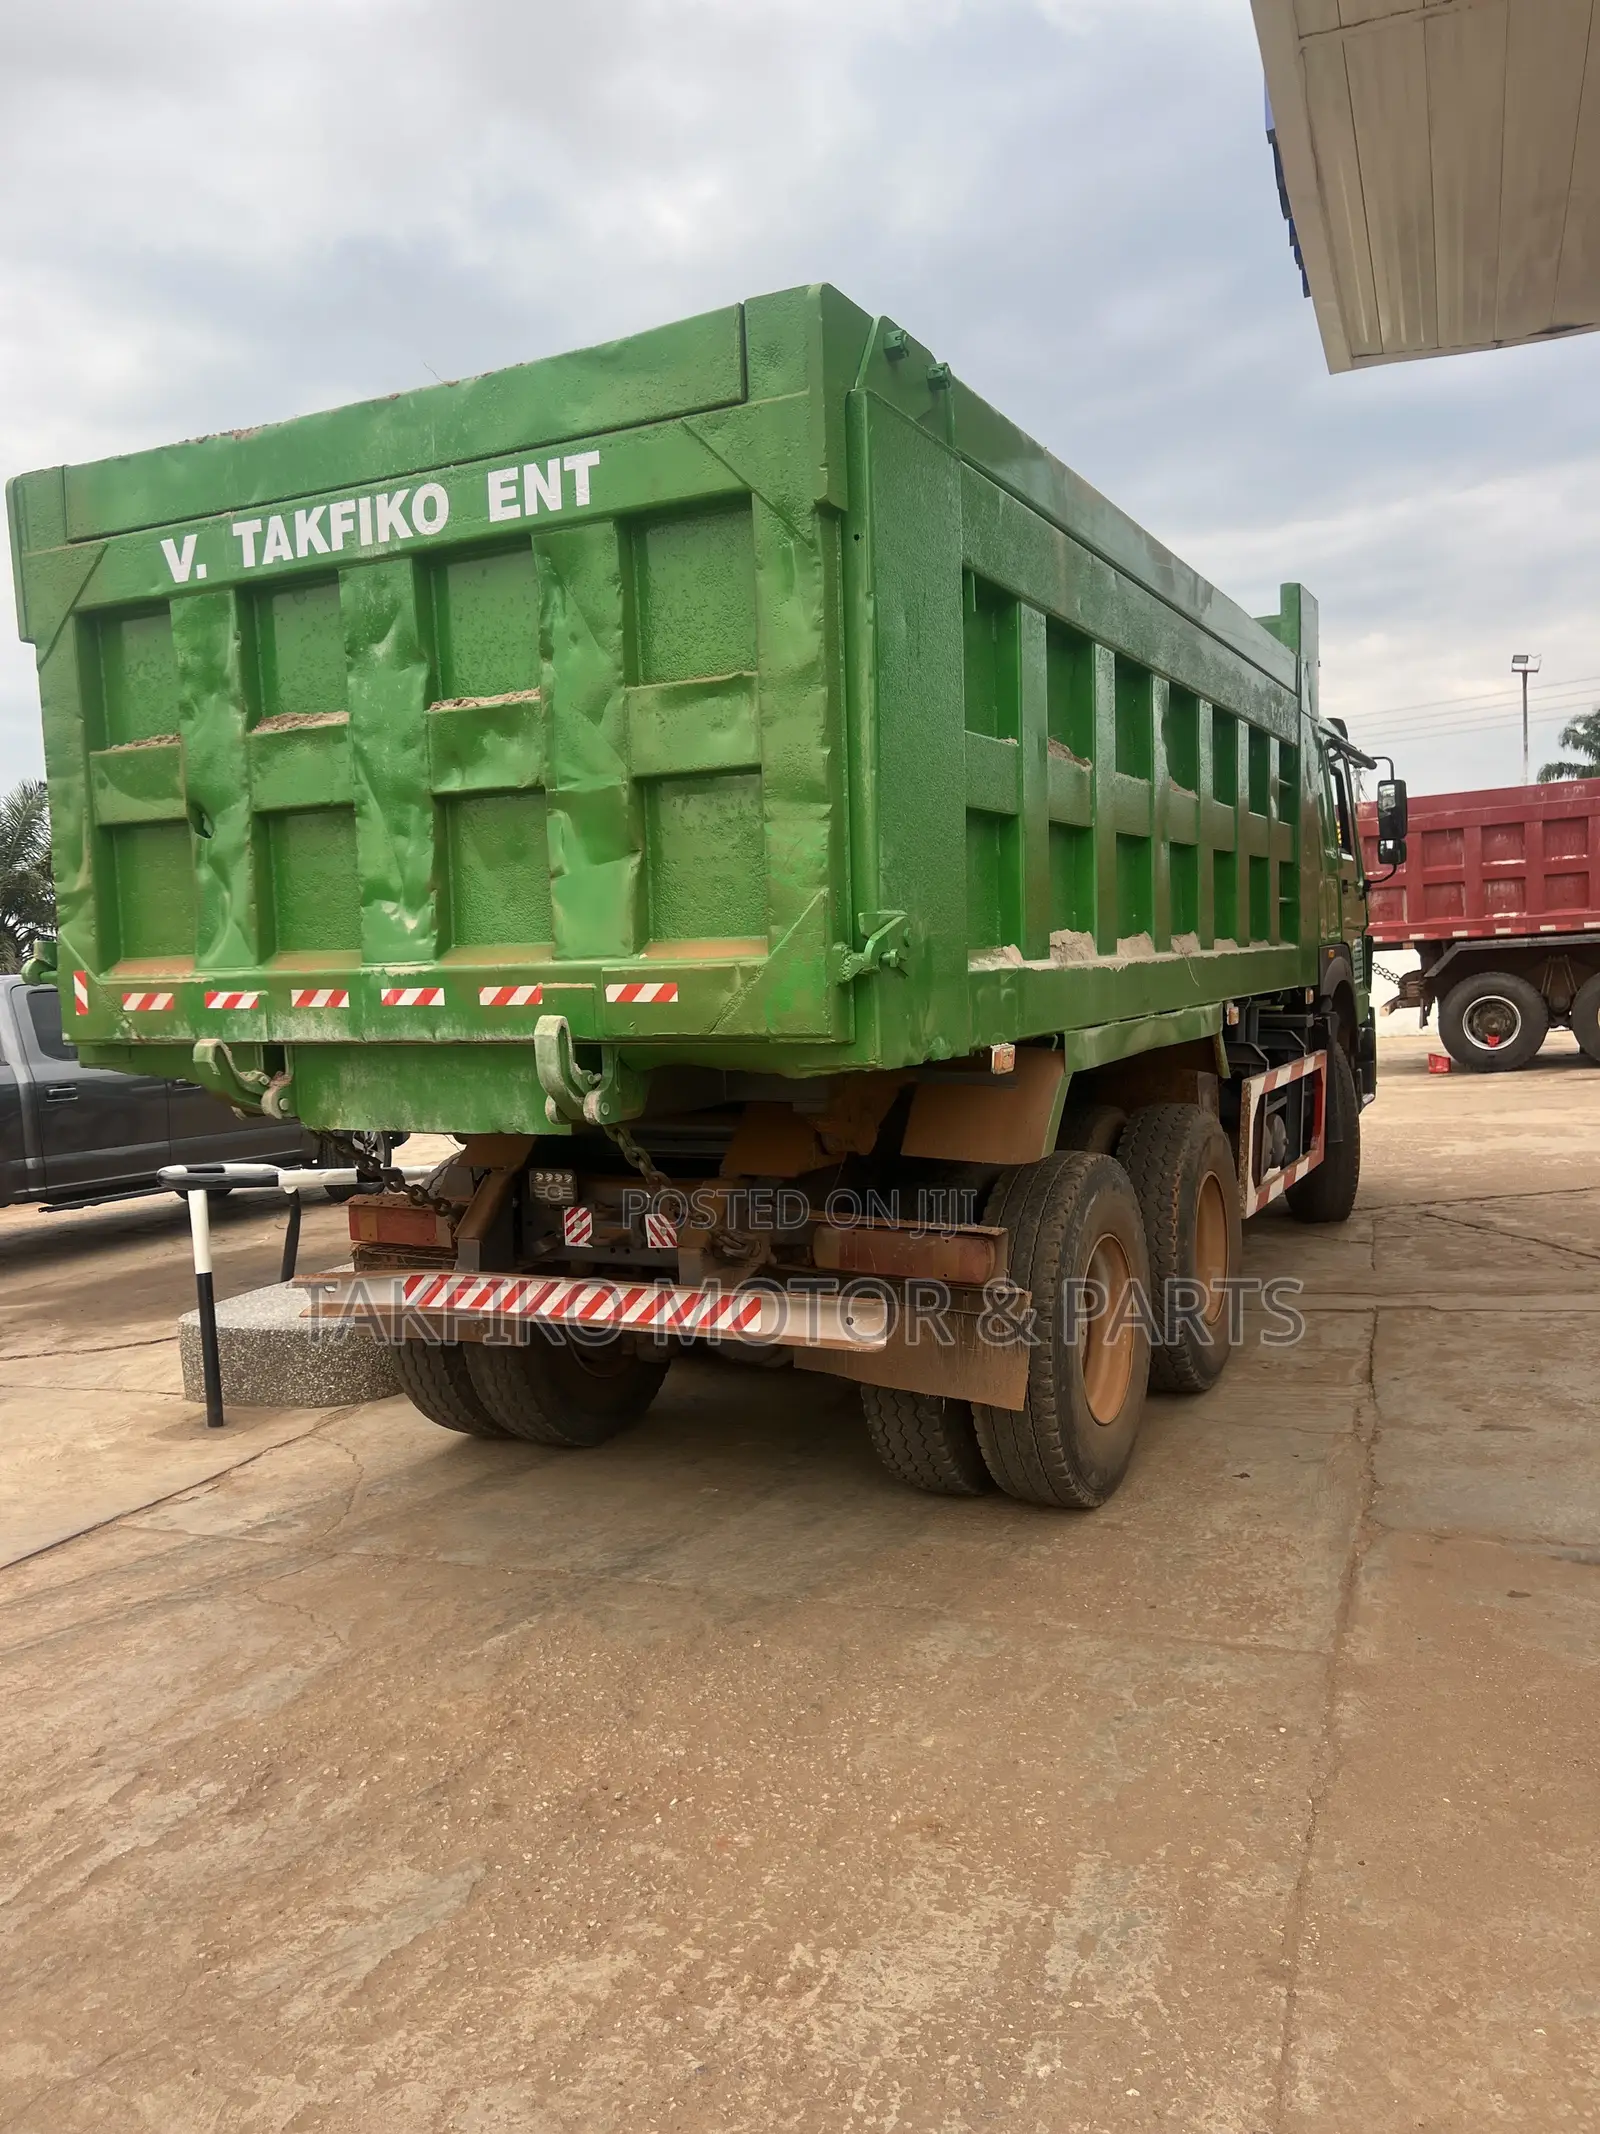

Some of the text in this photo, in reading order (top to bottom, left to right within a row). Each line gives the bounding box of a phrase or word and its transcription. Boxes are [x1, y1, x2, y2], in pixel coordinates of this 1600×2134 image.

[160, 450, 600, 584] V. TAKFIKO ENT
